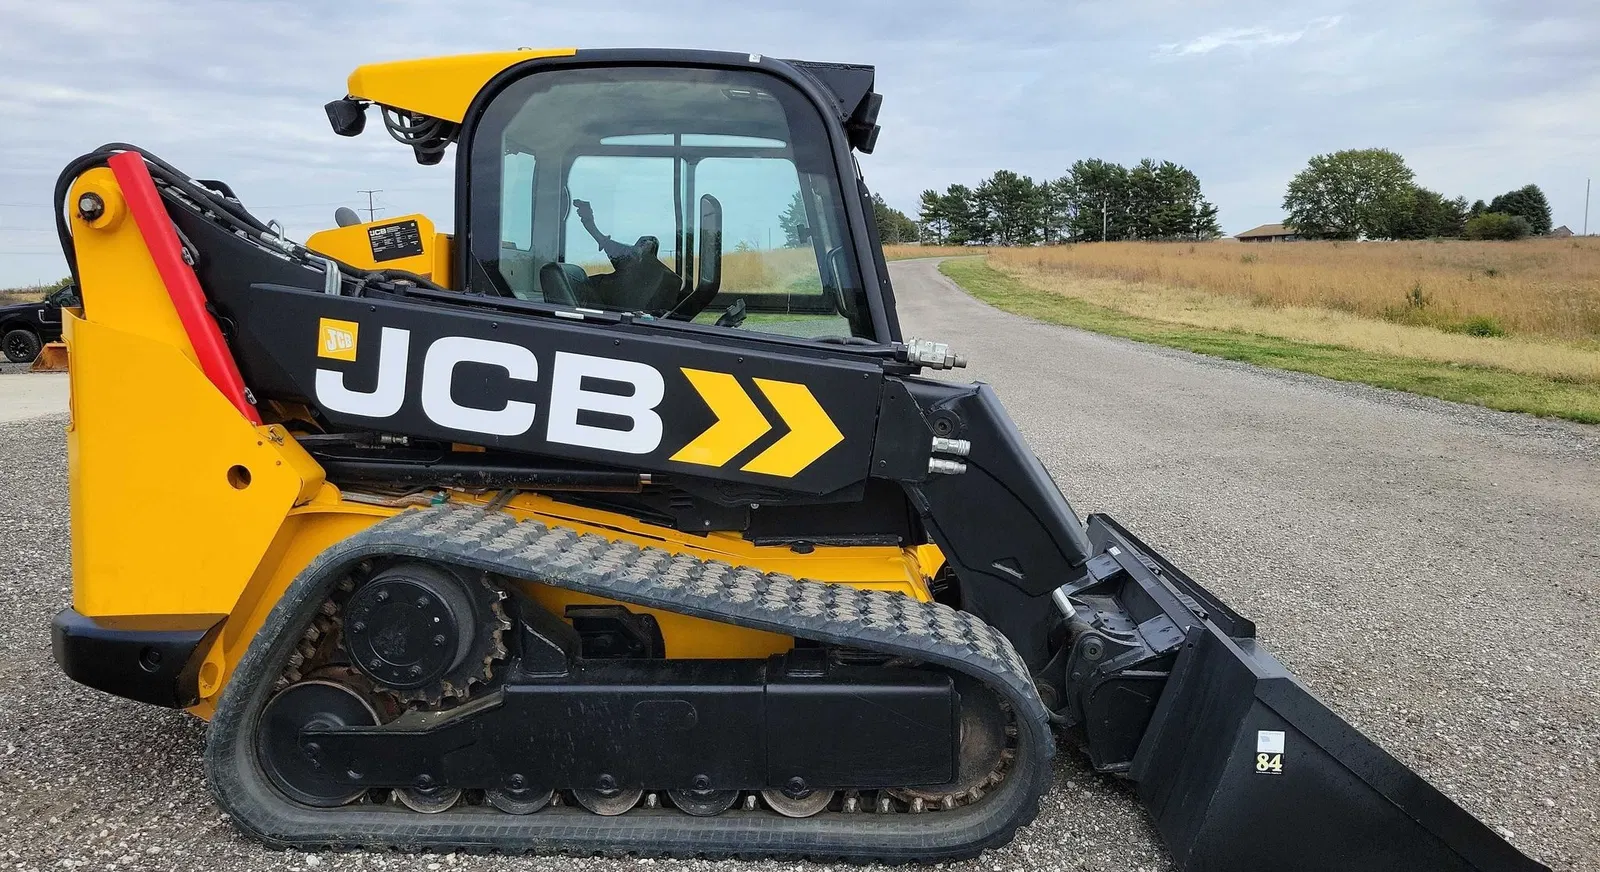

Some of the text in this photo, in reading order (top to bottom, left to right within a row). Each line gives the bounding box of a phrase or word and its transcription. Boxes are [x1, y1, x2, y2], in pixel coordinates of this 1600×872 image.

[370, 228, 386, 236] JCB
[326, 329, 353, 351] JCB
[315, 326, 665, 454] JCB
[1256, 753, 1282, 771] 84
